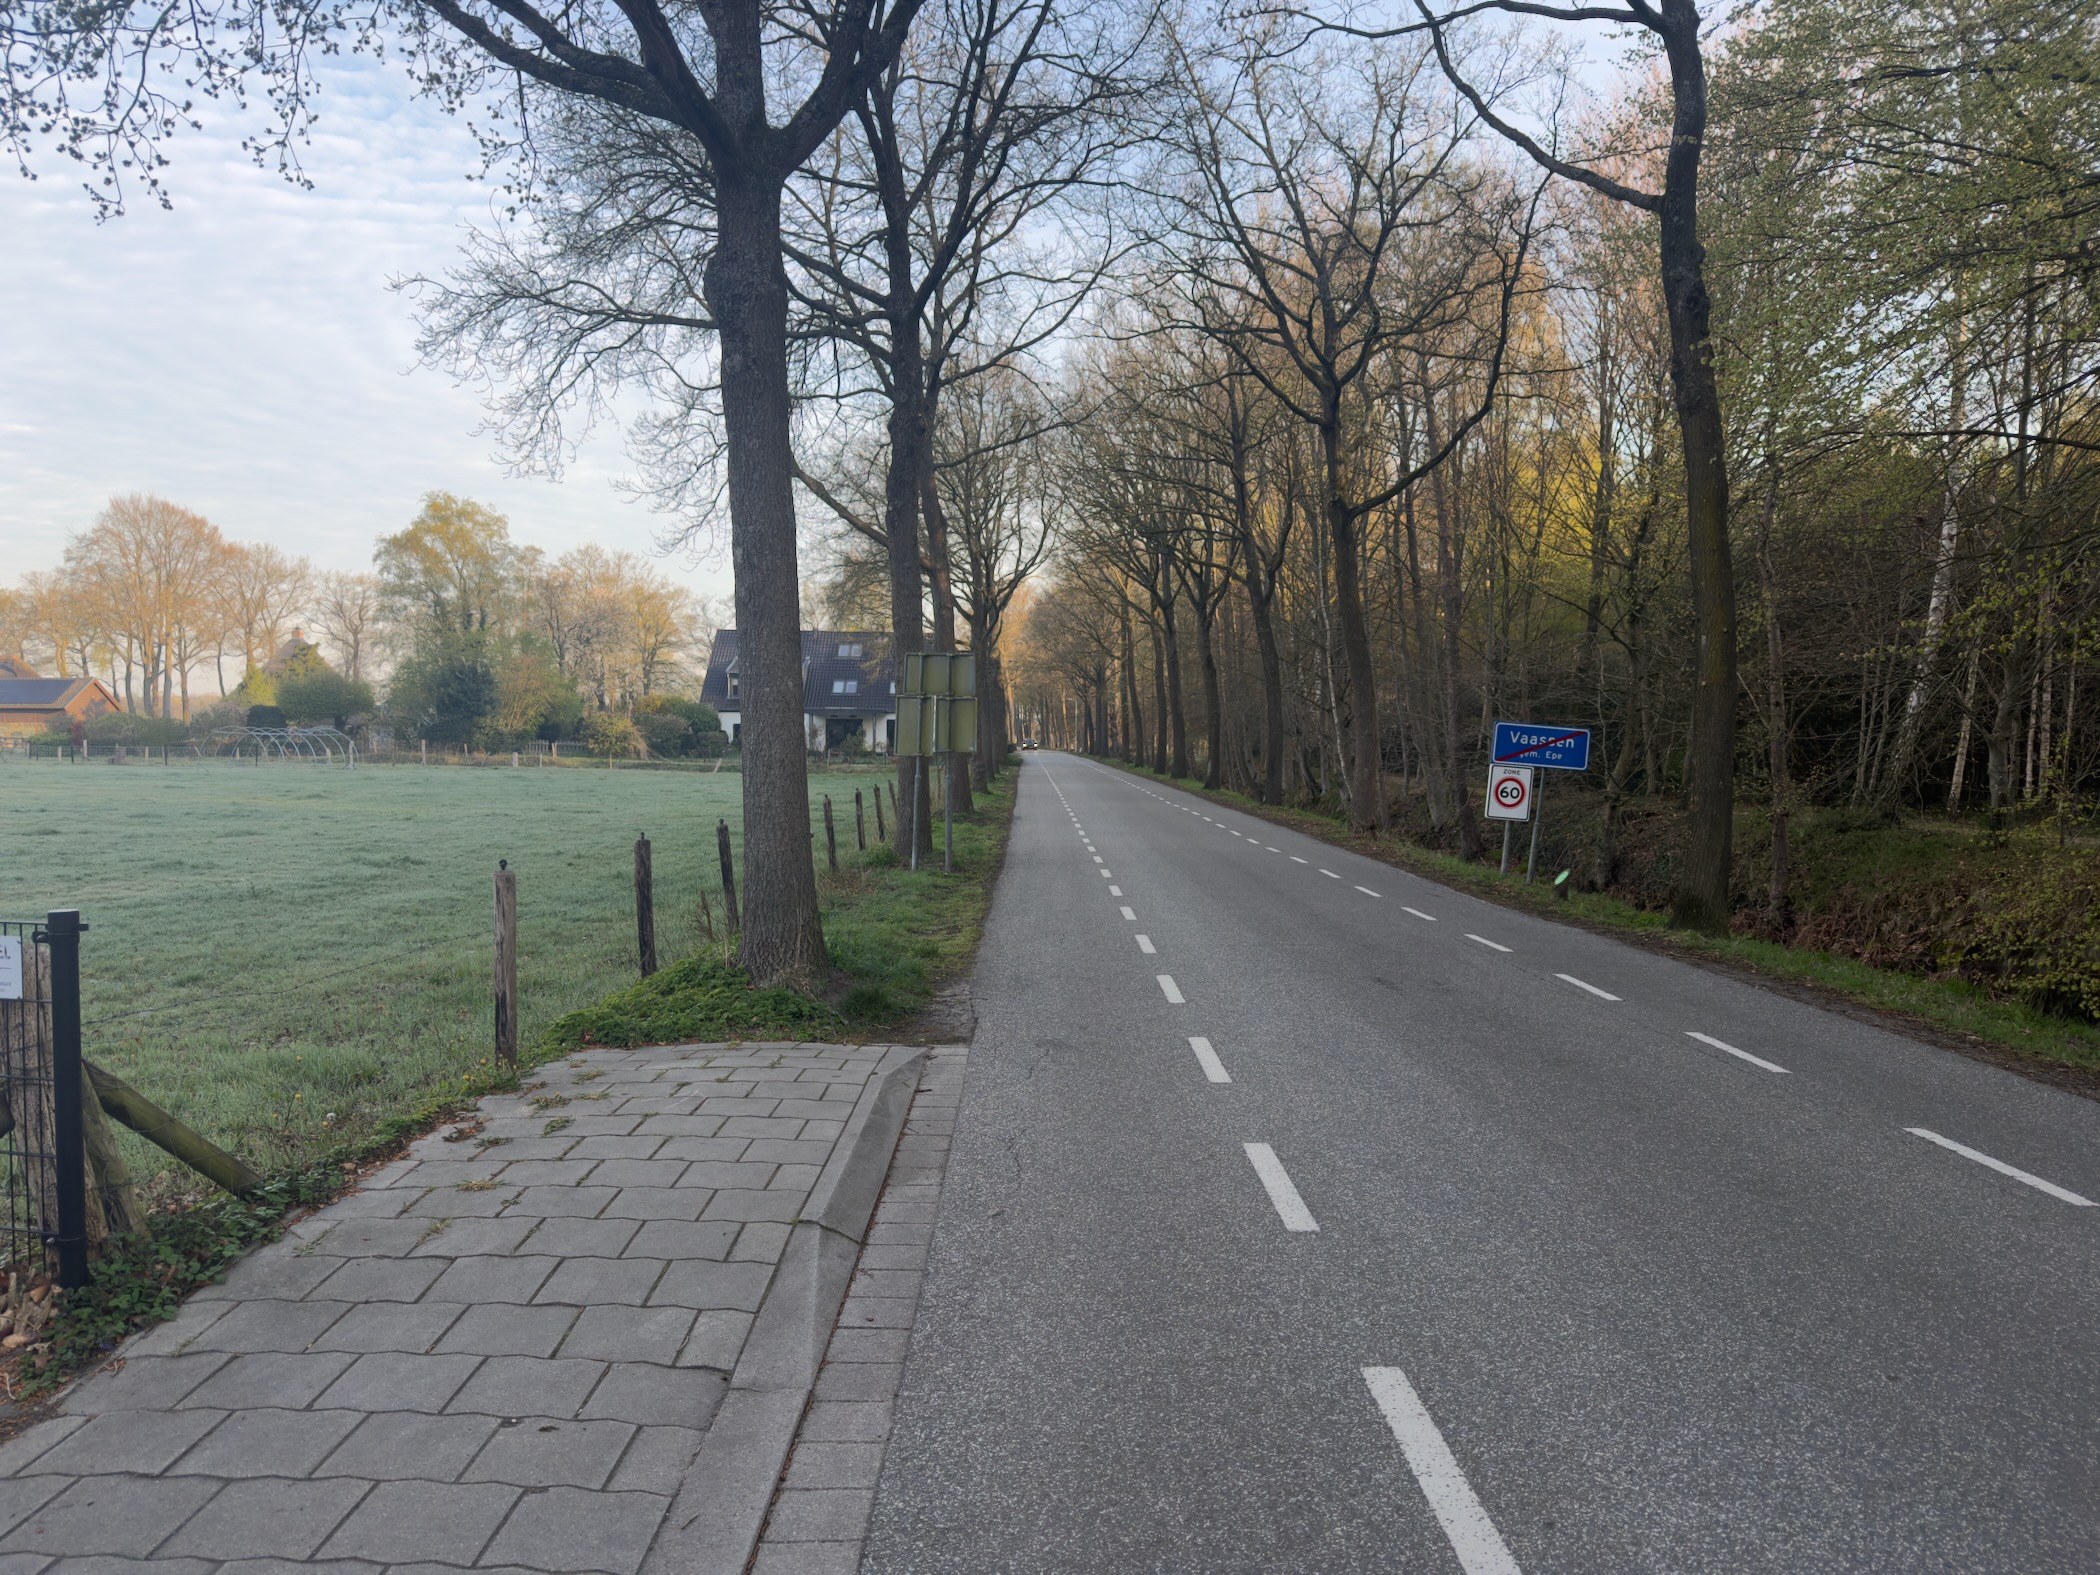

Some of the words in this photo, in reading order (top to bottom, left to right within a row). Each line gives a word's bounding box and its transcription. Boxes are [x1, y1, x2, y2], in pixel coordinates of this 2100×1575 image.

[1510, 731, 1574, 748] Vaassen
[1545, 750, 1562, 760] Epe
[1499, 786, 1520, 799] 60
